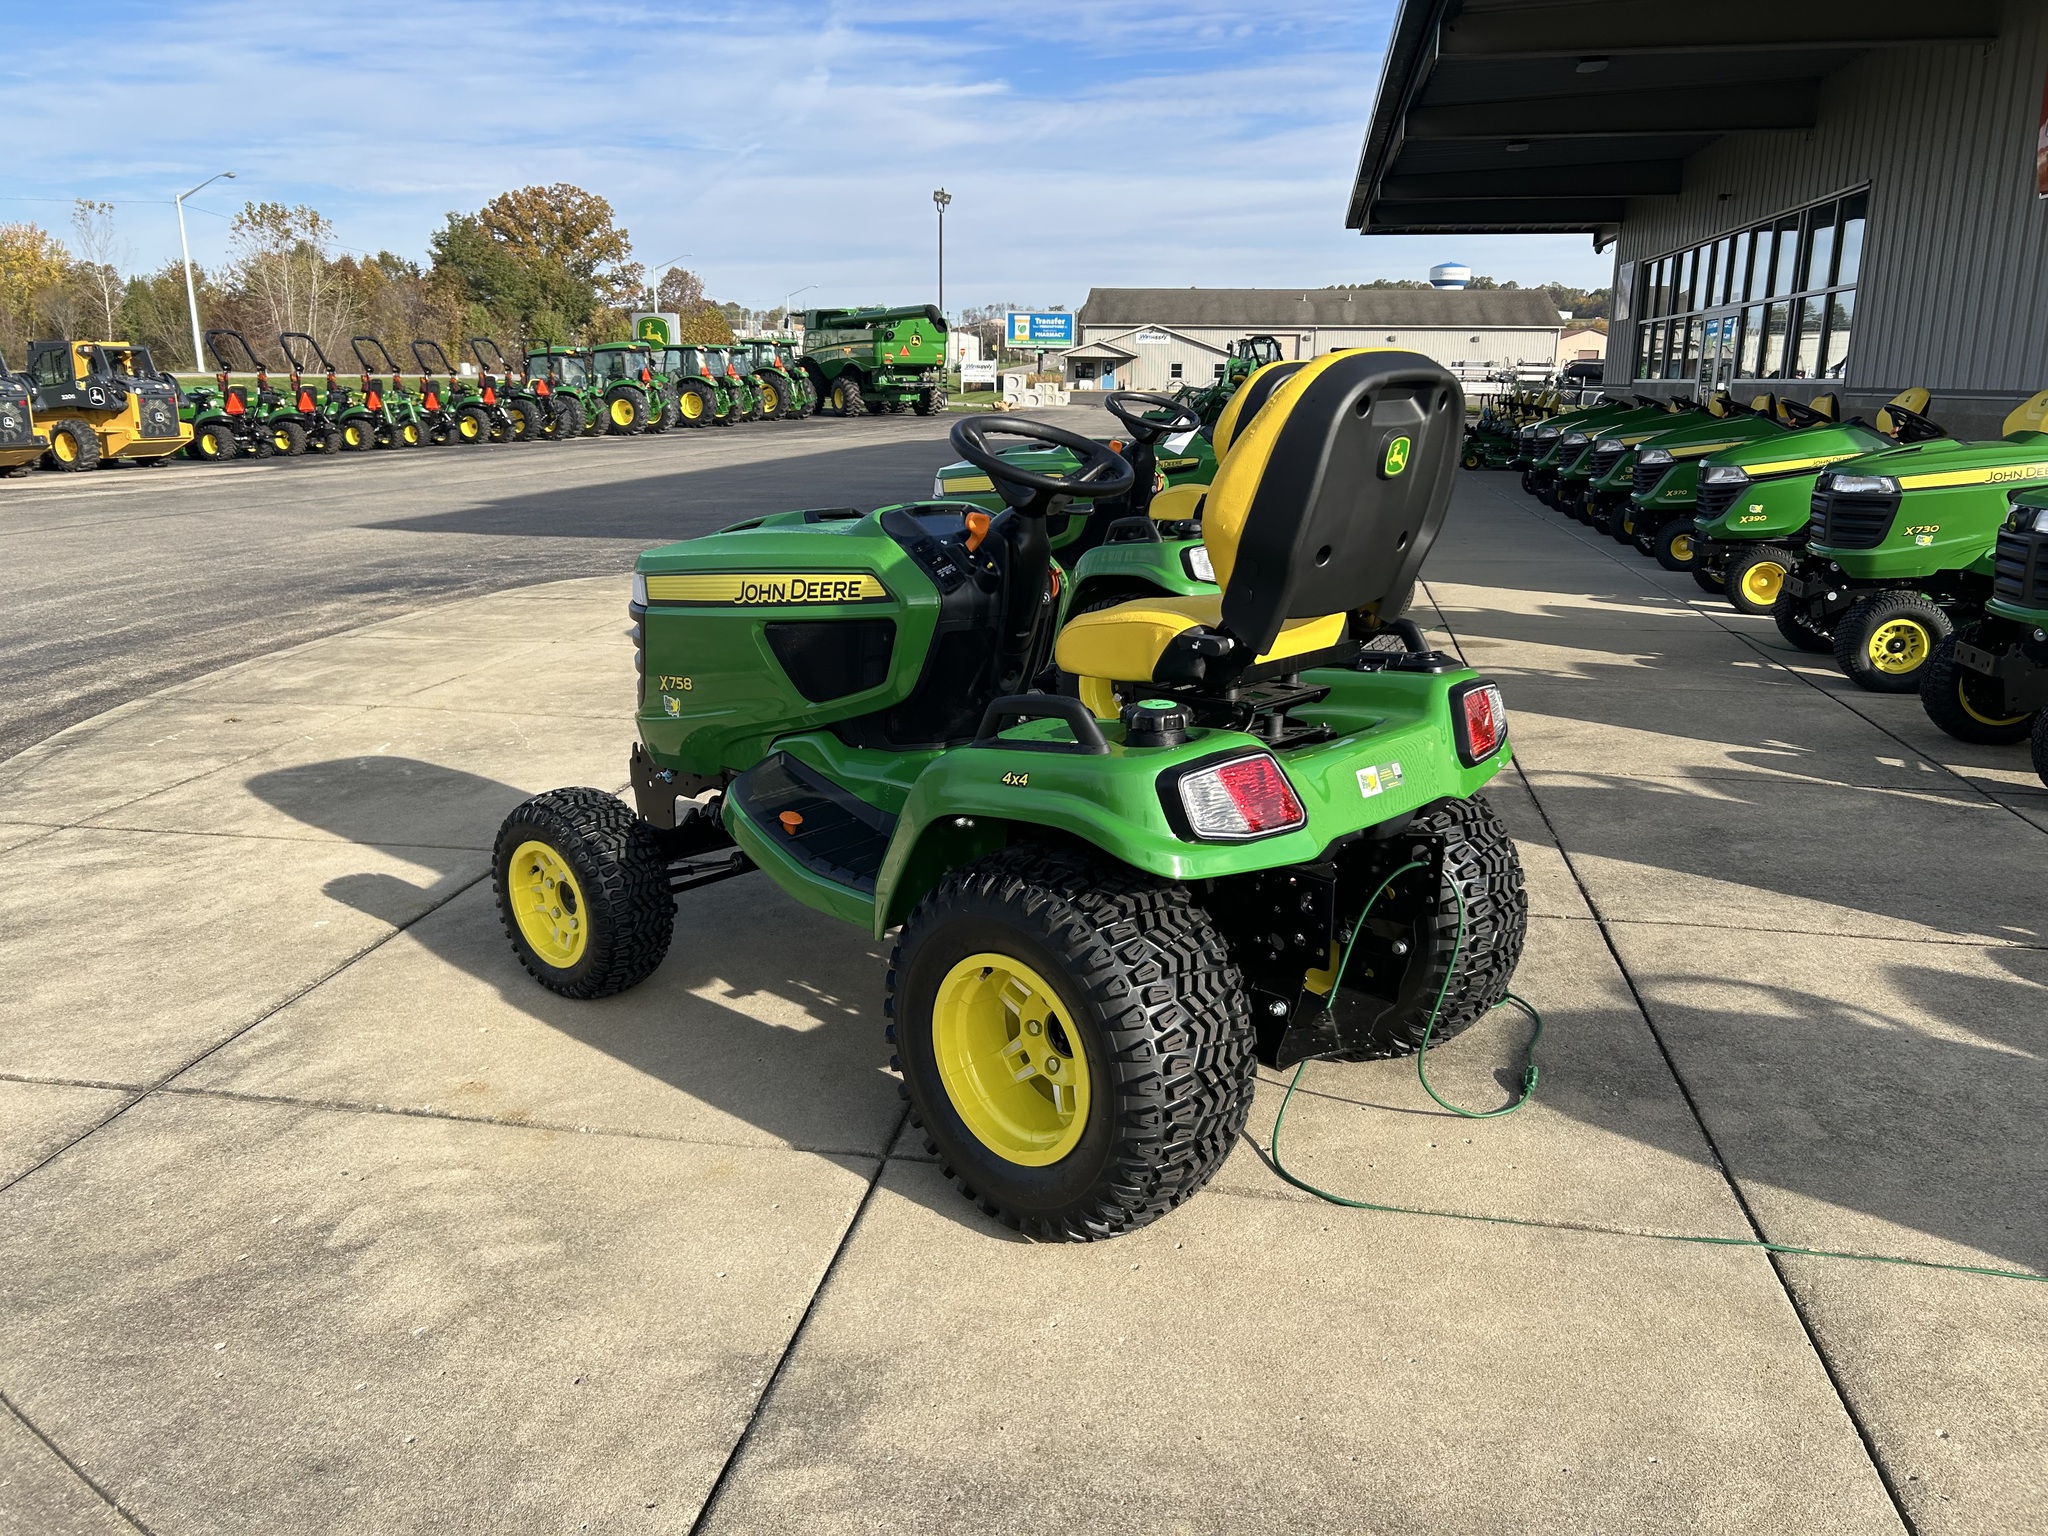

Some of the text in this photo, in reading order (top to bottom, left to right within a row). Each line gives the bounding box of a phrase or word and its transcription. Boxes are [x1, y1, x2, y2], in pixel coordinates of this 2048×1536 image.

[1035, 317, 1066, 325] Transfer
[965, 363, 993, 371] Winsupply
[1984, 470, 2023, 482] JOHN
[1665, 489, 1688, 497] X370
[1739, 515, 1767, 524] X390
[1903, 525, 1940, 536] X730
[734, 579, 862, 601] JOHN DEERE
[659, 675, 693, 691] X758
[1001, 771, 1029, 787] 4x4
